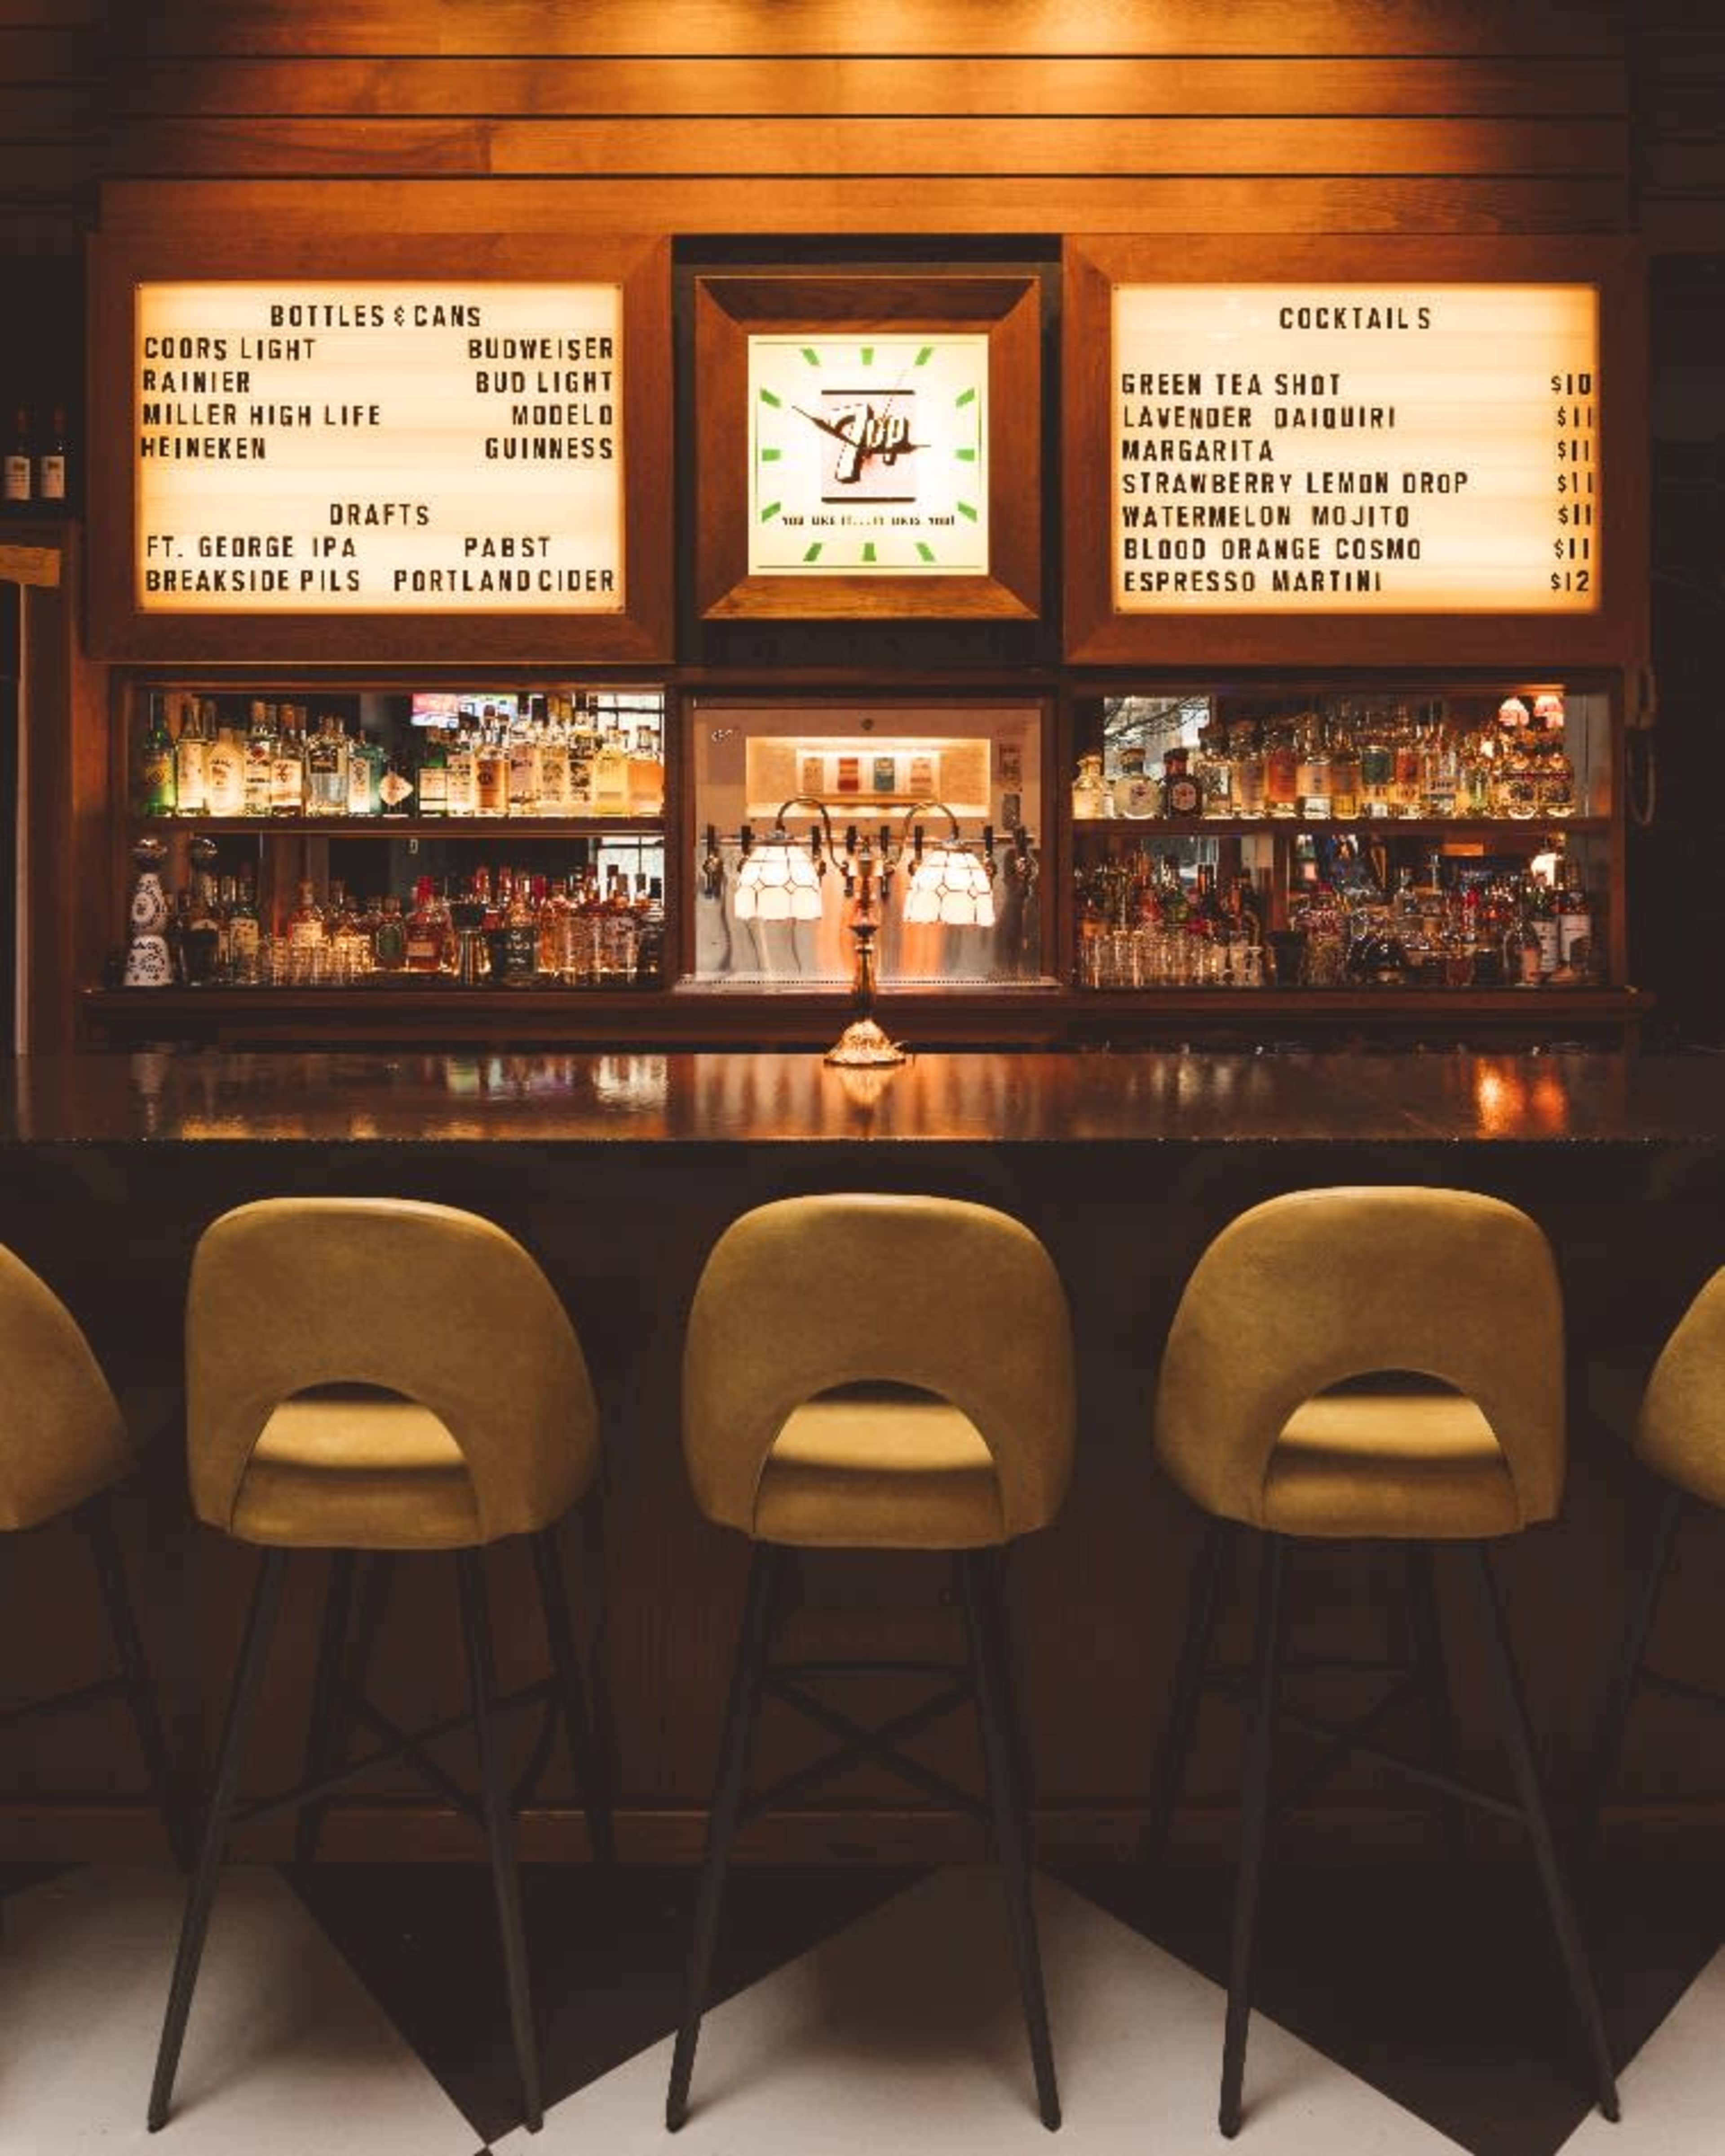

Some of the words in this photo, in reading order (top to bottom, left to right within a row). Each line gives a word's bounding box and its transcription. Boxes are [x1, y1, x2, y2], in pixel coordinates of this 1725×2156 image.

[271, 305, 384, 327] BOTTLES
[394, 306, 404, 327] &
[415, 305, 480, 327] CANS
[1280, 307, 1429, 329] COCKTAILS
[145, 337, 226, 361] COORS
[241, 337, 315, 361] LIGHT
[469, 337, 612, 361] BUDWEISER
[143, 369, 249, 393] RAINIER
[476, 371, 525, 393] BUD
[538, 371, 612, 393] LIGHT
[1122, 373, 1201, 395] GREEN
[1216, 373, 1262, 395] TEA
[1275, 373, 1340, 395] SHOT
[1551, 373, 1591, 395] $10
[143, 403, 236, 425] MILLER
[250, 405, 311, 427] HIGH
[325, 405, 379, 426] LIFE
[513, 403, 612, 425] MODELO
[1124, 406, 1251, 429] LAVENDER
[1275, 406, 1394, 429] DAIQUIRI
[1558, 406, 1592, 428] $11
[140, 436, 265, 459] HEINEKEN
[486, 437, 612, 459] GUINNESS
[1122, 439, 1274, 462] MARGARITA
[1558, 440, 1589, 462] $11
[1123, 472, 1292, 494] STRAWBERRY
[1307, 472, 1388, 494] LEMON
[1403, 472, 1468, 494] DROP
[1558, 472, 1593, 494] $11
[330, 504, 429, 526] DRAFTS
[1122, 506, 1290, 528] WATERMELON
[1312, 506, 1408, 528] MOJITO
[1558, 504, 1591, 526] $11
[147, 535, 183, 557] FT.
[199, 535, 293, 557] GEORGE
[313, 536, 355, 557] IPA
[465, 536, 549, 557] PABST
[1124, 538, 1205, 560] BLOOD
[1222, 538, 1319, 560] ORANGE
[1336, 538, 1420, 560] COSMO
[1554, 538, 1589, 560] $11
[146, 570, 289, 592] BREAKSIDE
[301, 570, 359, 592] PILS
[1124, 570, 1255, 592] ESPRESSO
[1273, 570, 1380, 592] MARTINI
[1551, 570, 1589, 592] $12
